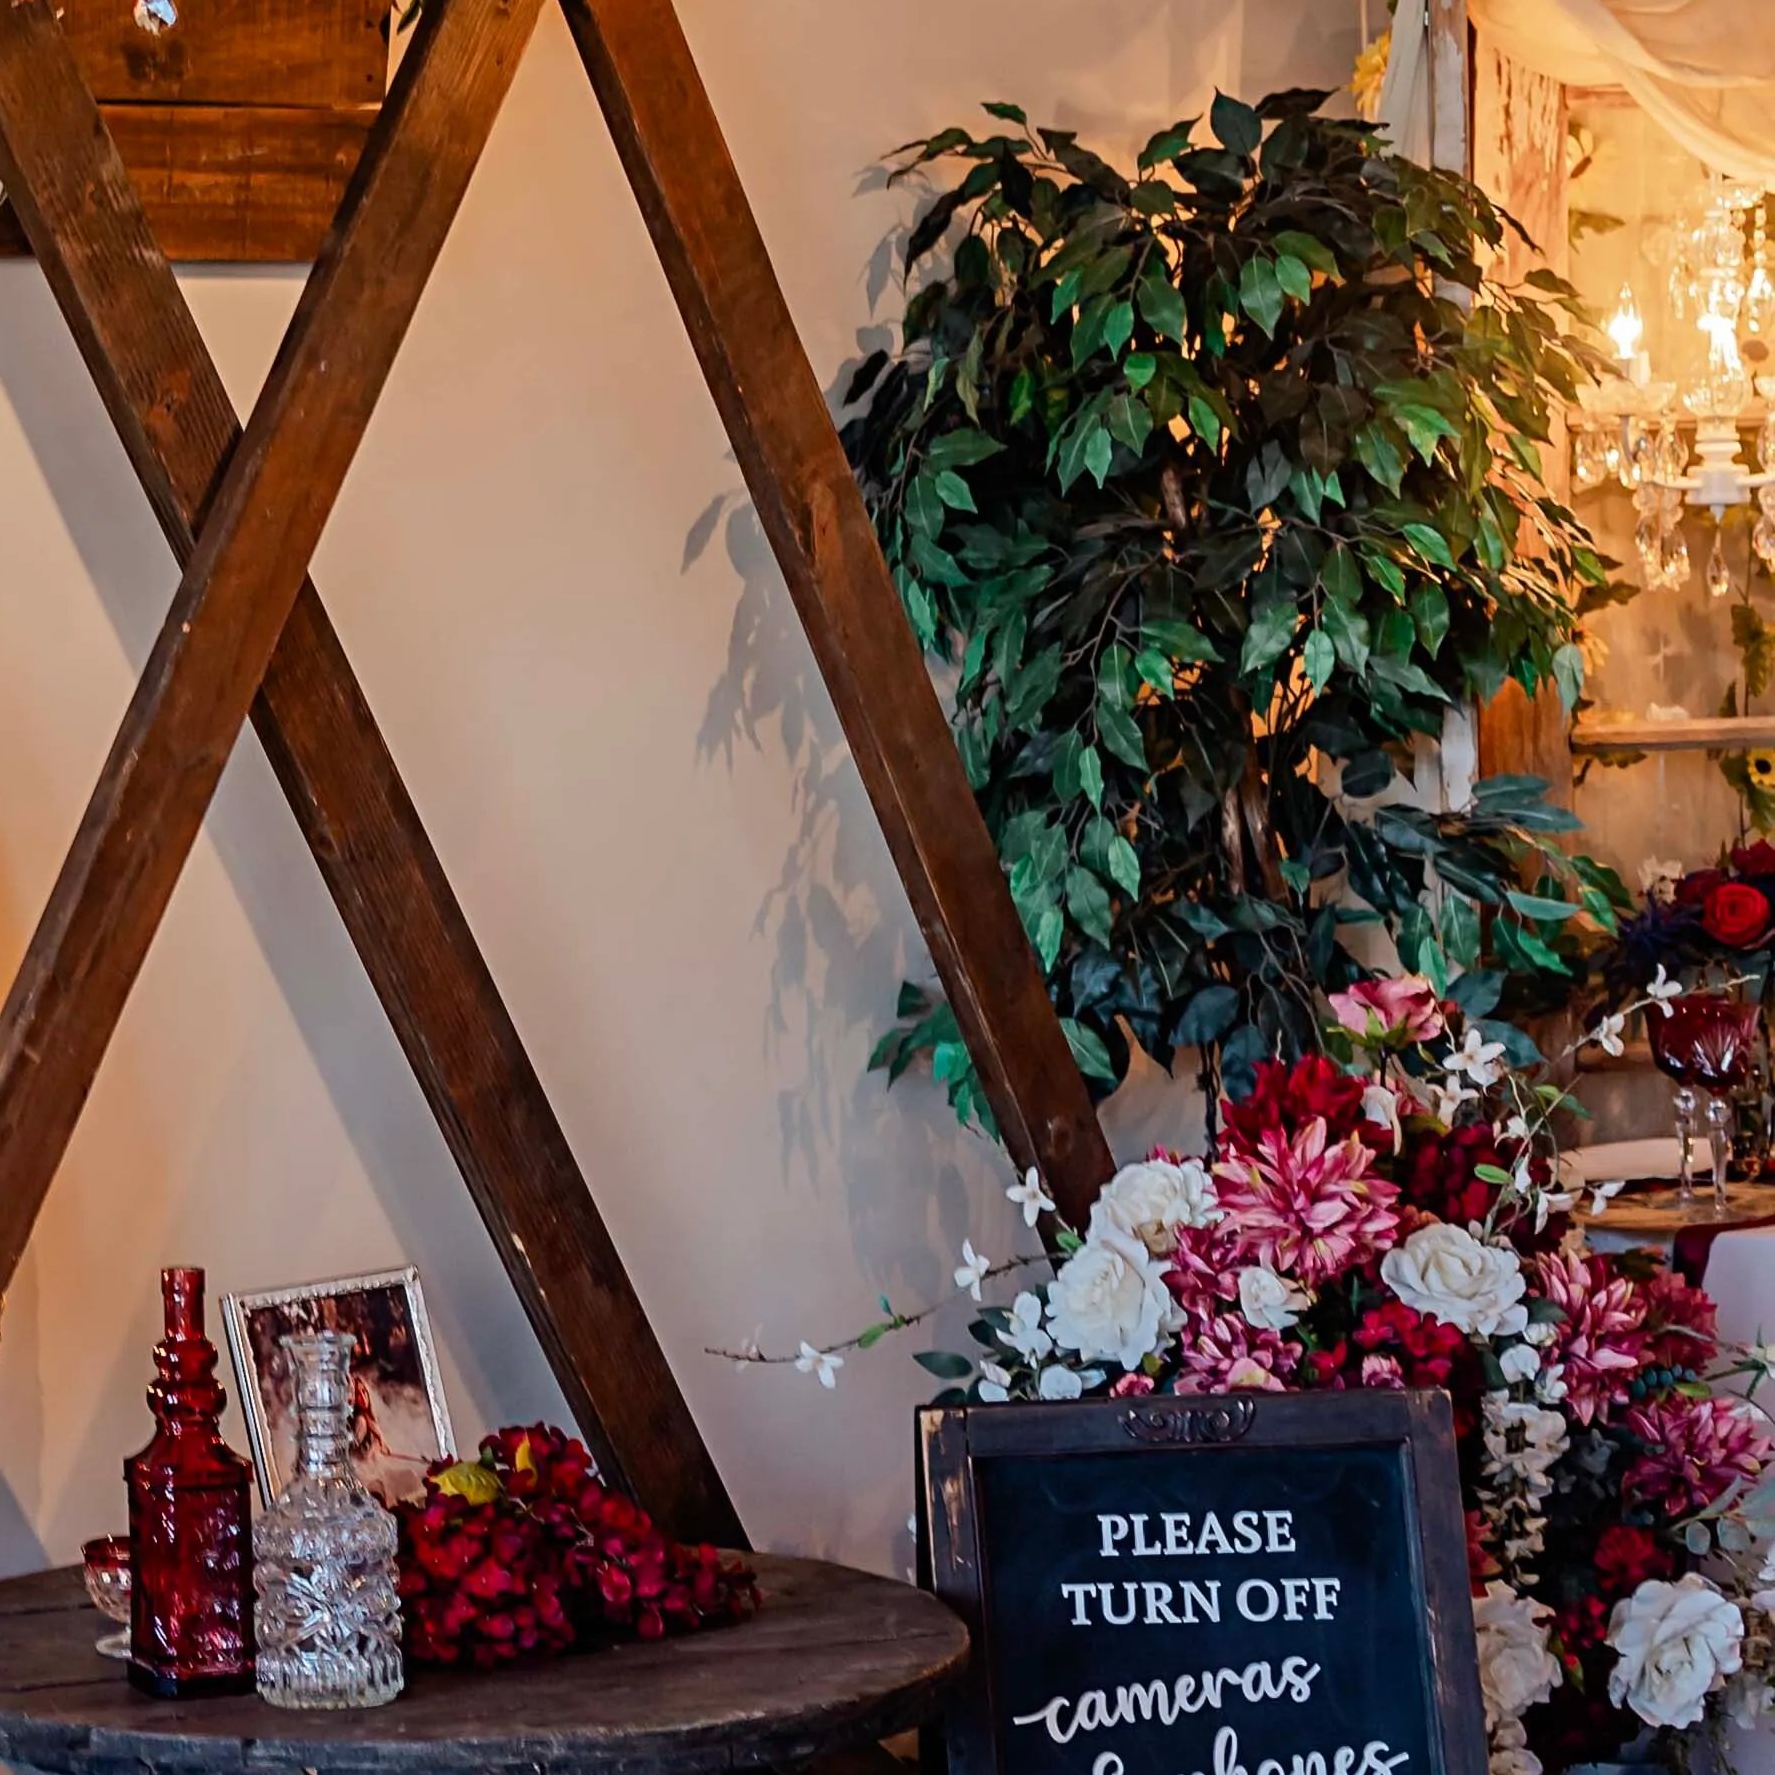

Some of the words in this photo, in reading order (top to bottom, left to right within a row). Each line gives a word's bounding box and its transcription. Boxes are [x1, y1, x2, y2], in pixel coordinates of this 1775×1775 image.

[1096, 1510, 1296, 1557] PLEASE
[1061, 1579, 1221, 1626] TURN
[1235, 1577, 1341, 1622] OFF
[1013, 1655, 1321, 1744] cameras
